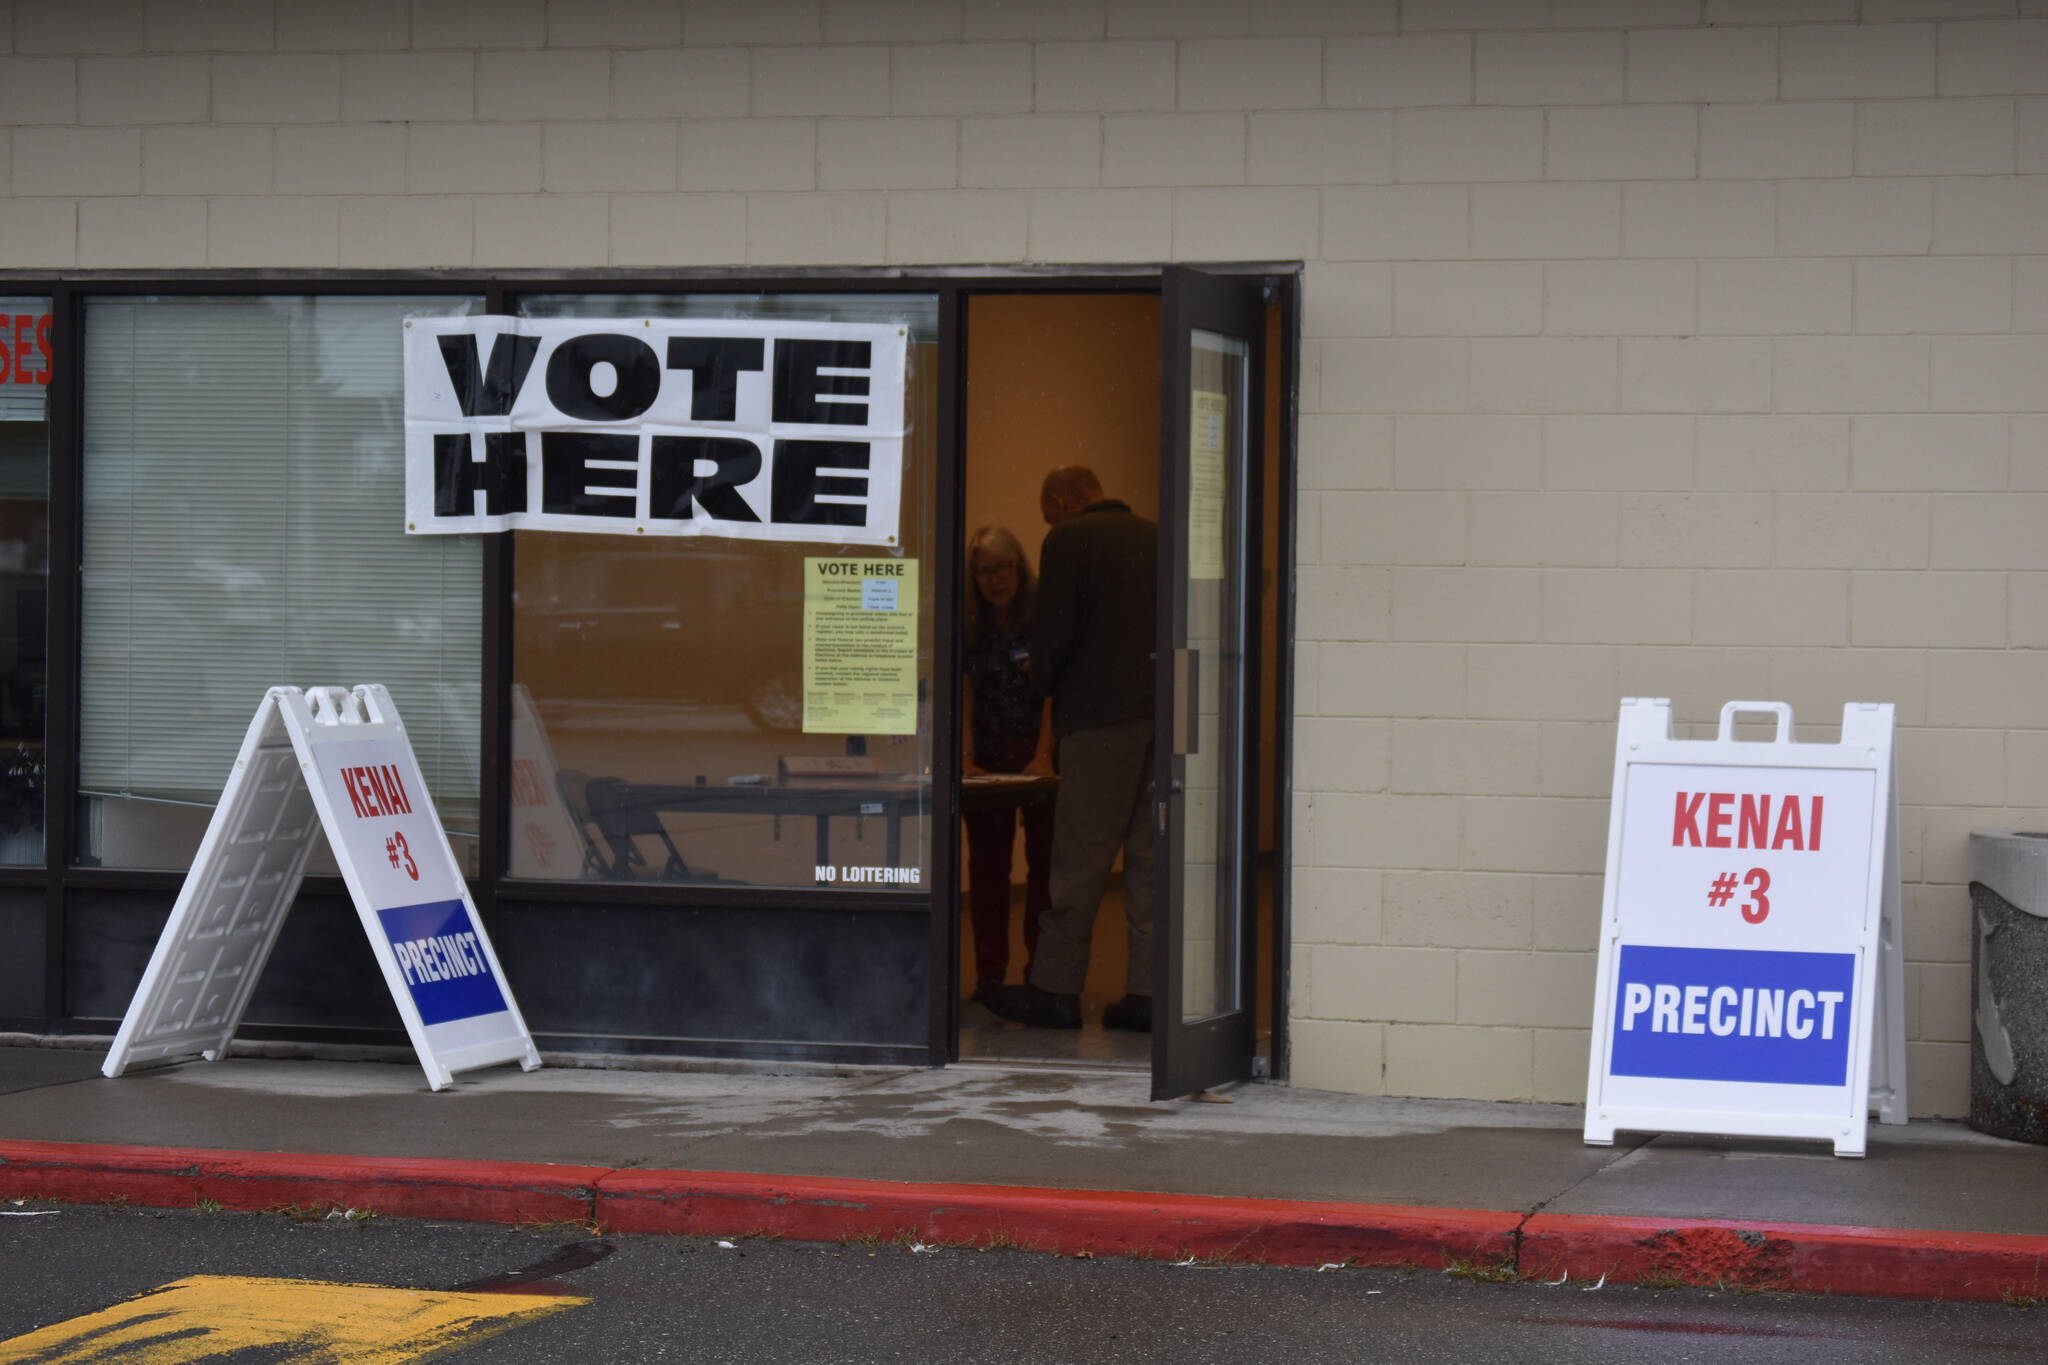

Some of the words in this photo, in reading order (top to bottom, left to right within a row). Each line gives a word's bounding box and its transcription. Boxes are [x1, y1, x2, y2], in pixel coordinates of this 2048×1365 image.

[436, 333, 872, 426] VOTE
[434, 431, 871, 527] HERE
[817, 563, 859, 576] VOTE
[863, 563, 905, 576] HERE
[340, 763, 413, 819] KENAI
[1671, 791, 1825, 852] KENAI
[385, 831, 420, 882] #3
[815, 865, 836, 882] NO
[842, 865, 921, 884] LOITERING
[1707, 867, 1771, 925] #3
[393, 931, 487, 986] PRECINCT
[1622, 983, 1845, 1041] PRECINCT
